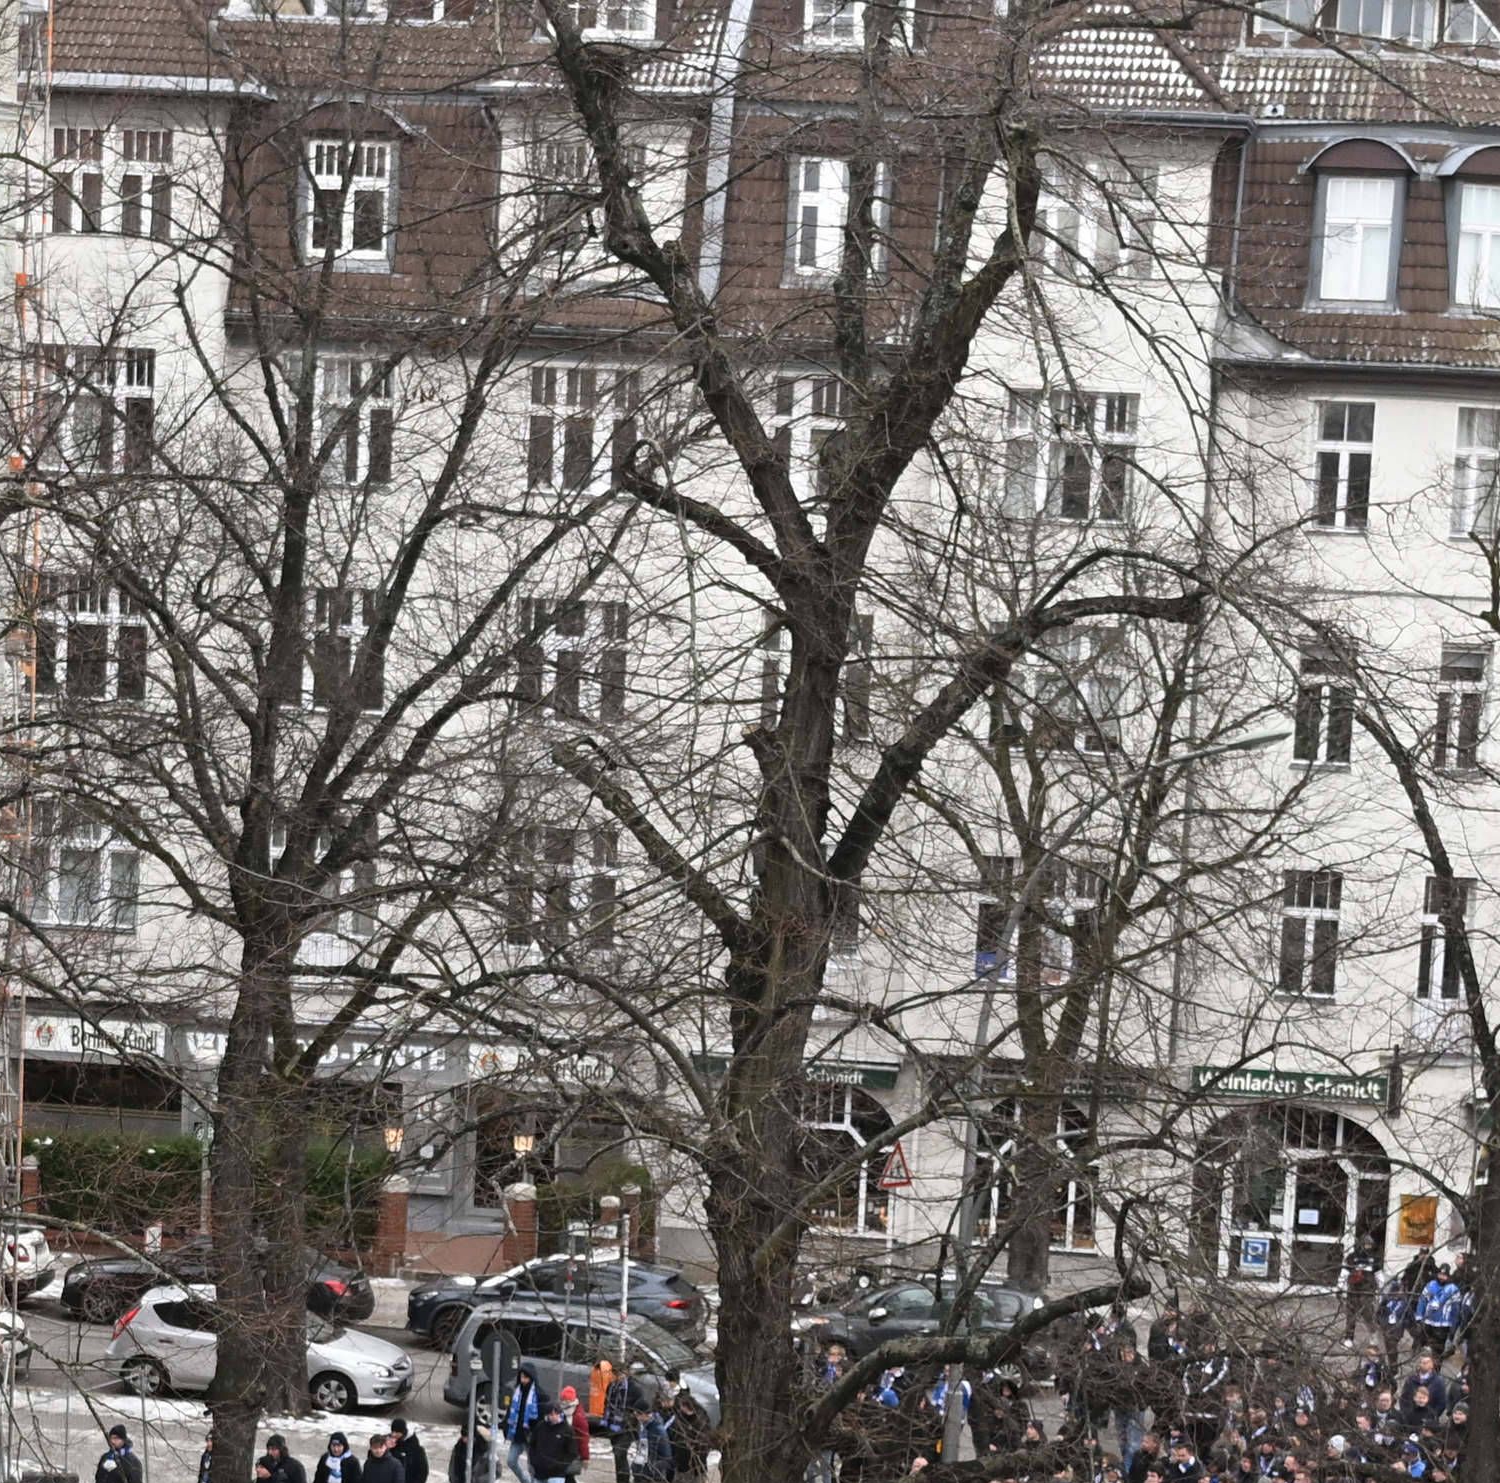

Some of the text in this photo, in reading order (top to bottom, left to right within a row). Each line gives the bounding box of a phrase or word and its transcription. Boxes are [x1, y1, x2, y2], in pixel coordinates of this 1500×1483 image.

[805, 1067, 864, 1085] Schmidt
[1198, 1070, 1381, 1099] Weinladen Schmidt
